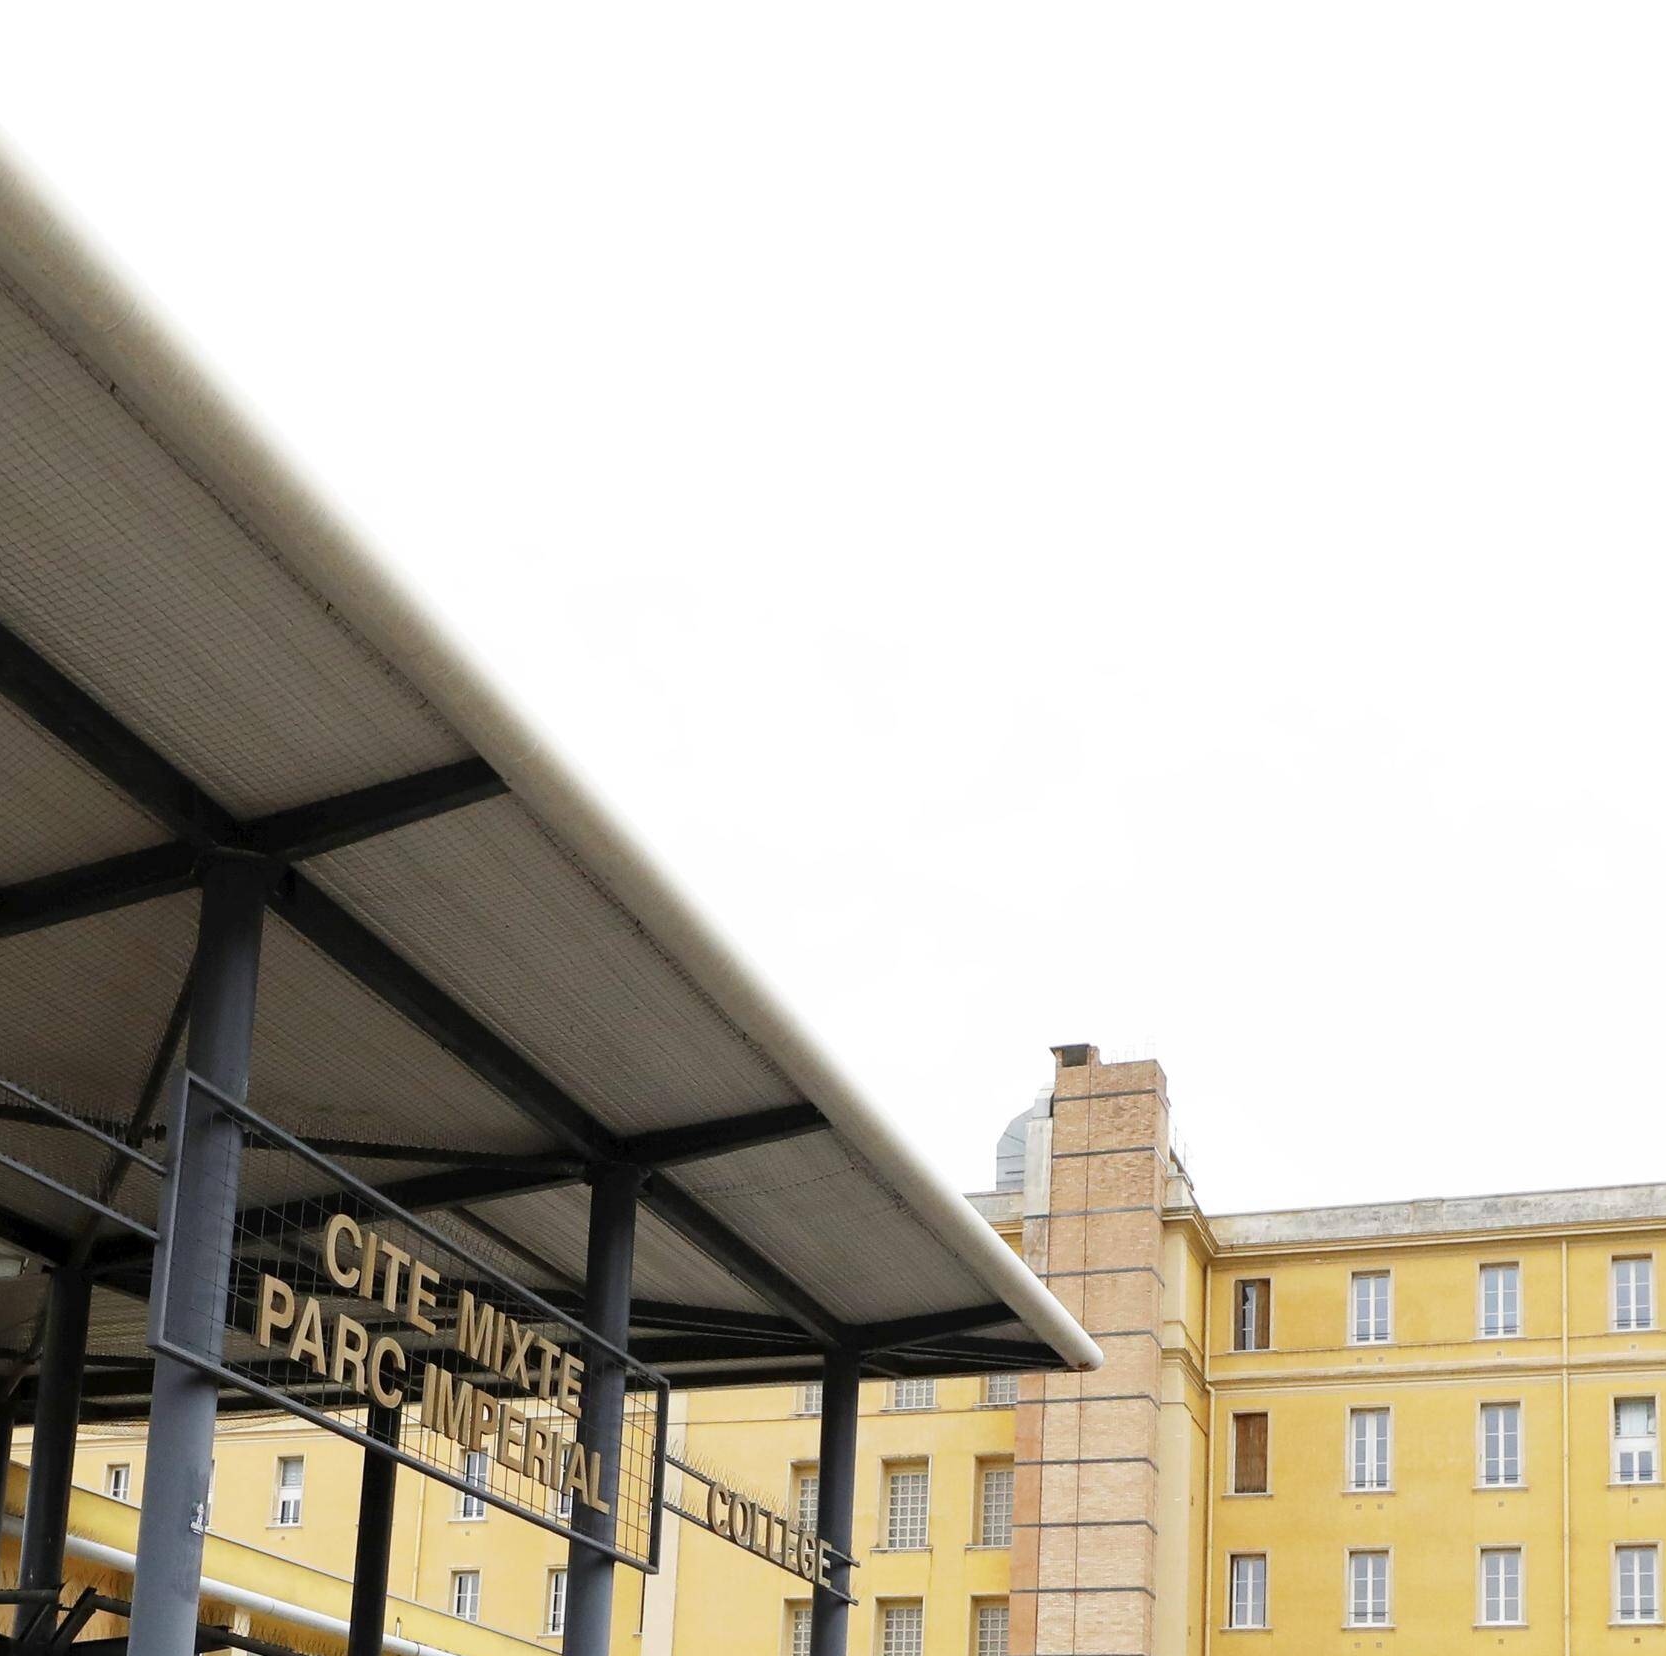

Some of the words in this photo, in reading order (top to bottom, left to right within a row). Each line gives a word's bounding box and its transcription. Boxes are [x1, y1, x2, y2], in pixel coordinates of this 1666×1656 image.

[257, 1273, 406, 1409] PARC
[420, 1362, 610, 1515] IMPERIAL
[325, 1213, 440, 1336] CITE
[455, 1288, 585, 1418] MIXTE
[707, 1481, 832, 1587] COLLEGE
